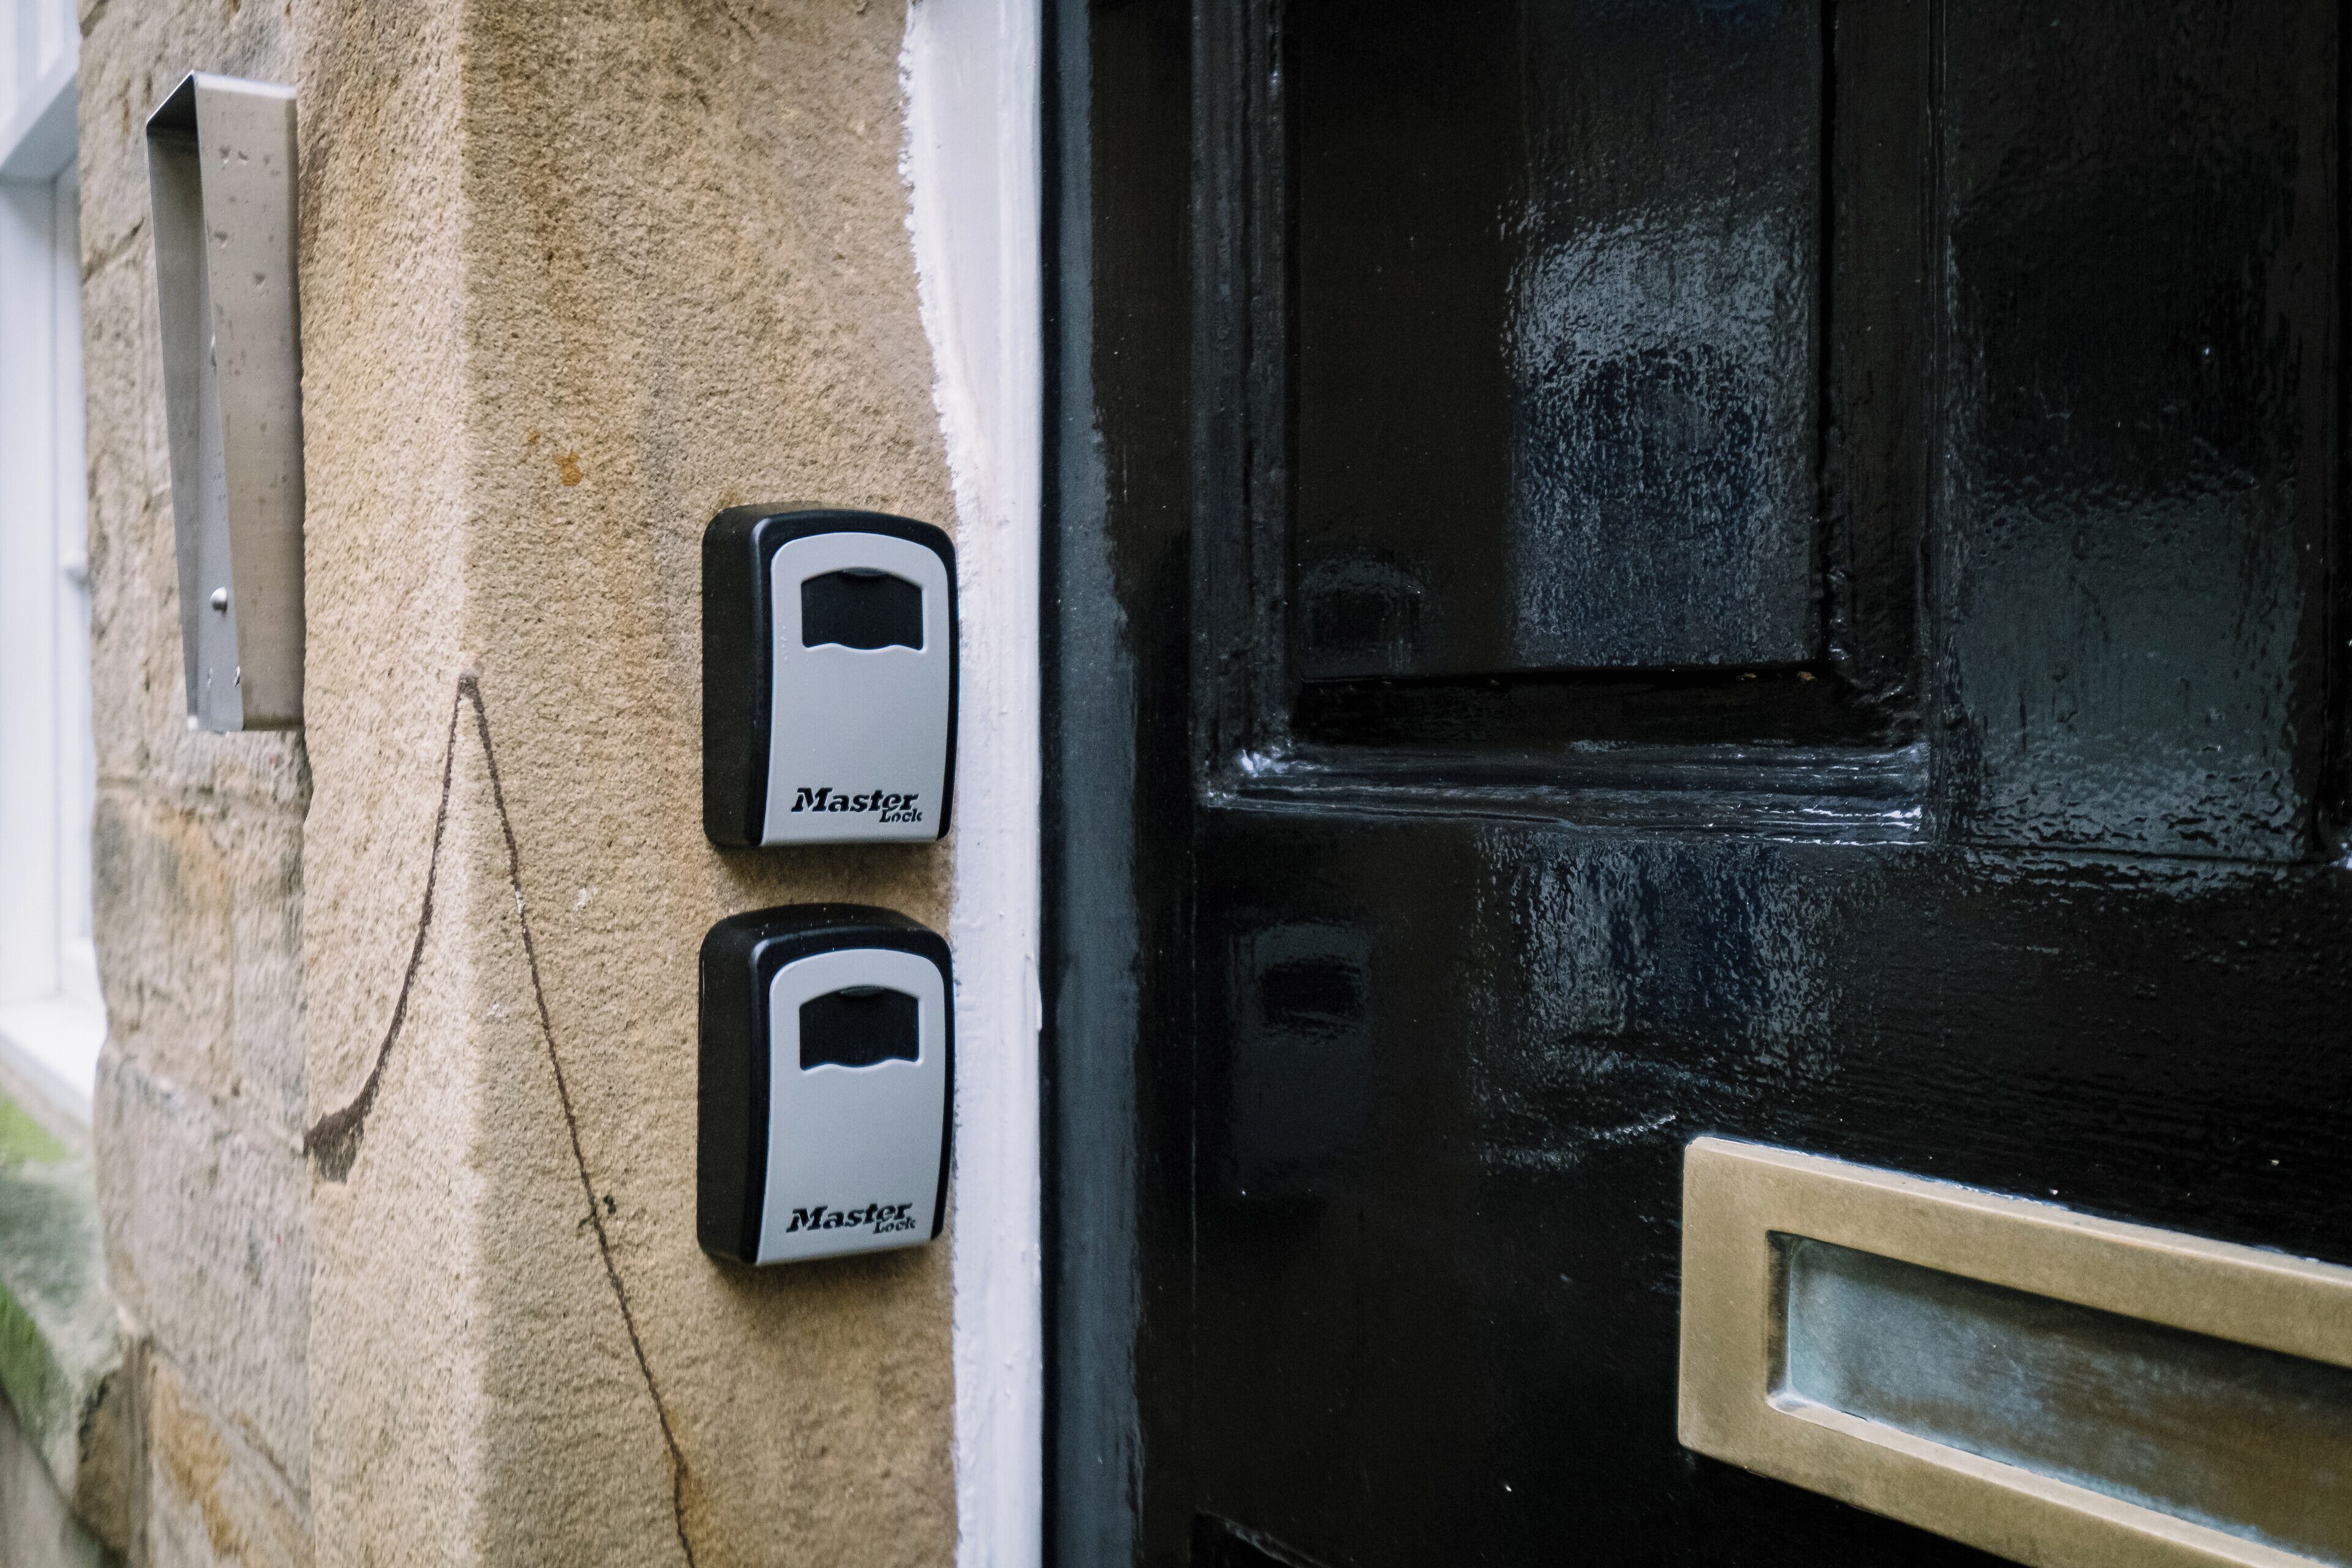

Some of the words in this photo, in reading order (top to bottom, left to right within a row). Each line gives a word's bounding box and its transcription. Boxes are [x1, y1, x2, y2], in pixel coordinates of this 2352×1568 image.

[791, 787, 919, 812] Master
[879, 809, 922, 823] Lock
[785, 1202, 913, 1233] Master
[872, 1216, 916, 1234] Lock
